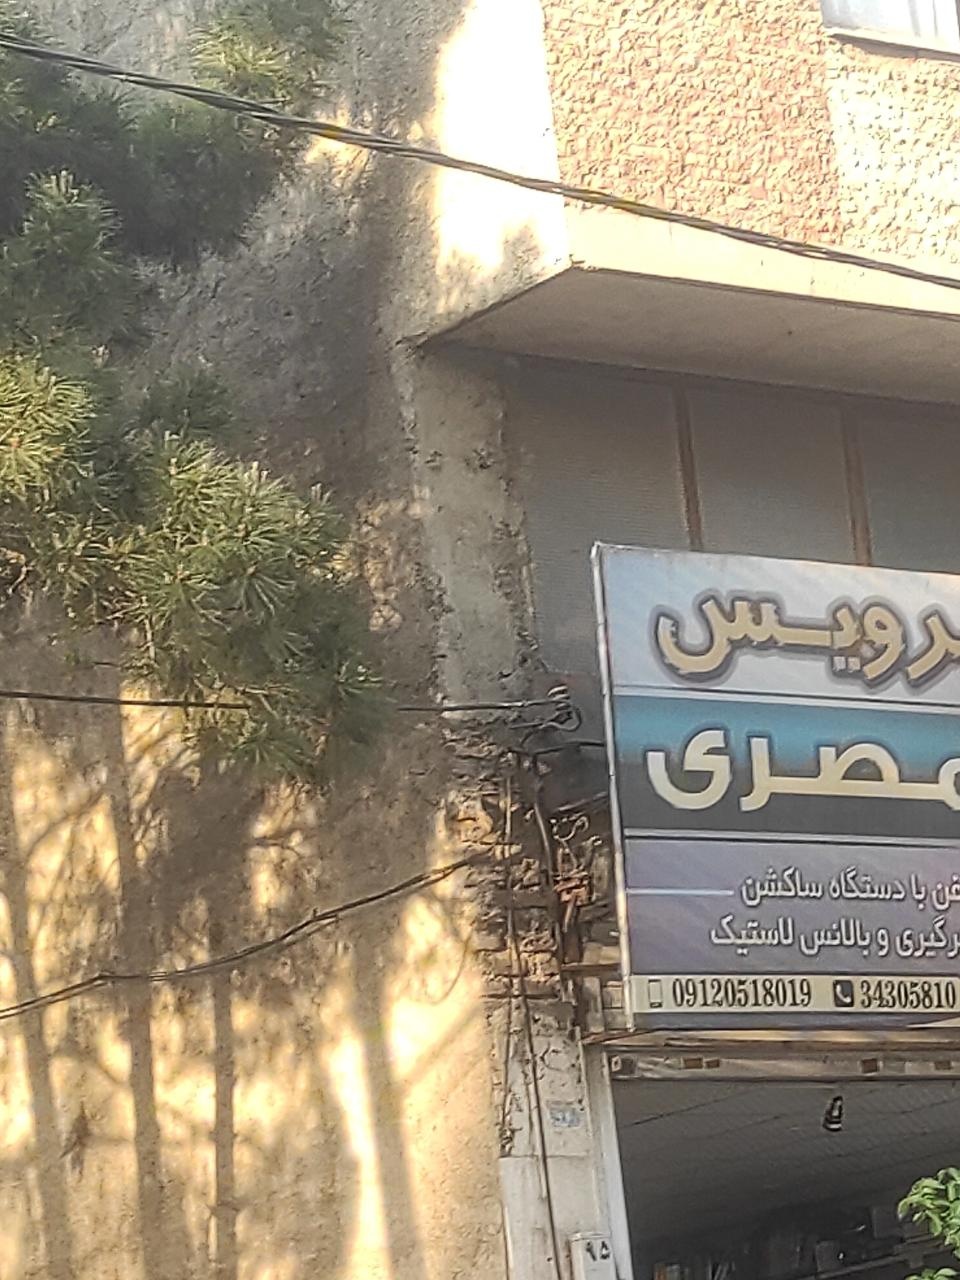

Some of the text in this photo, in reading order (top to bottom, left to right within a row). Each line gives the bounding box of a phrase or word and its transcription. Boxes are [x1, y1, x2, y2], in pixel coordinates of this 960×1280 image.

[740, 866, 823, 907] ساکشن
[828, 868, 907, 900] دستگاه
[910, 874, 927, 910] با
[710, 913, 794, 956] لاستیک
[800, 917, 873, 956] بالانس
[877, 929, 890, 949] و
[672, 978, 957, 1010] 09120518019 34305810
